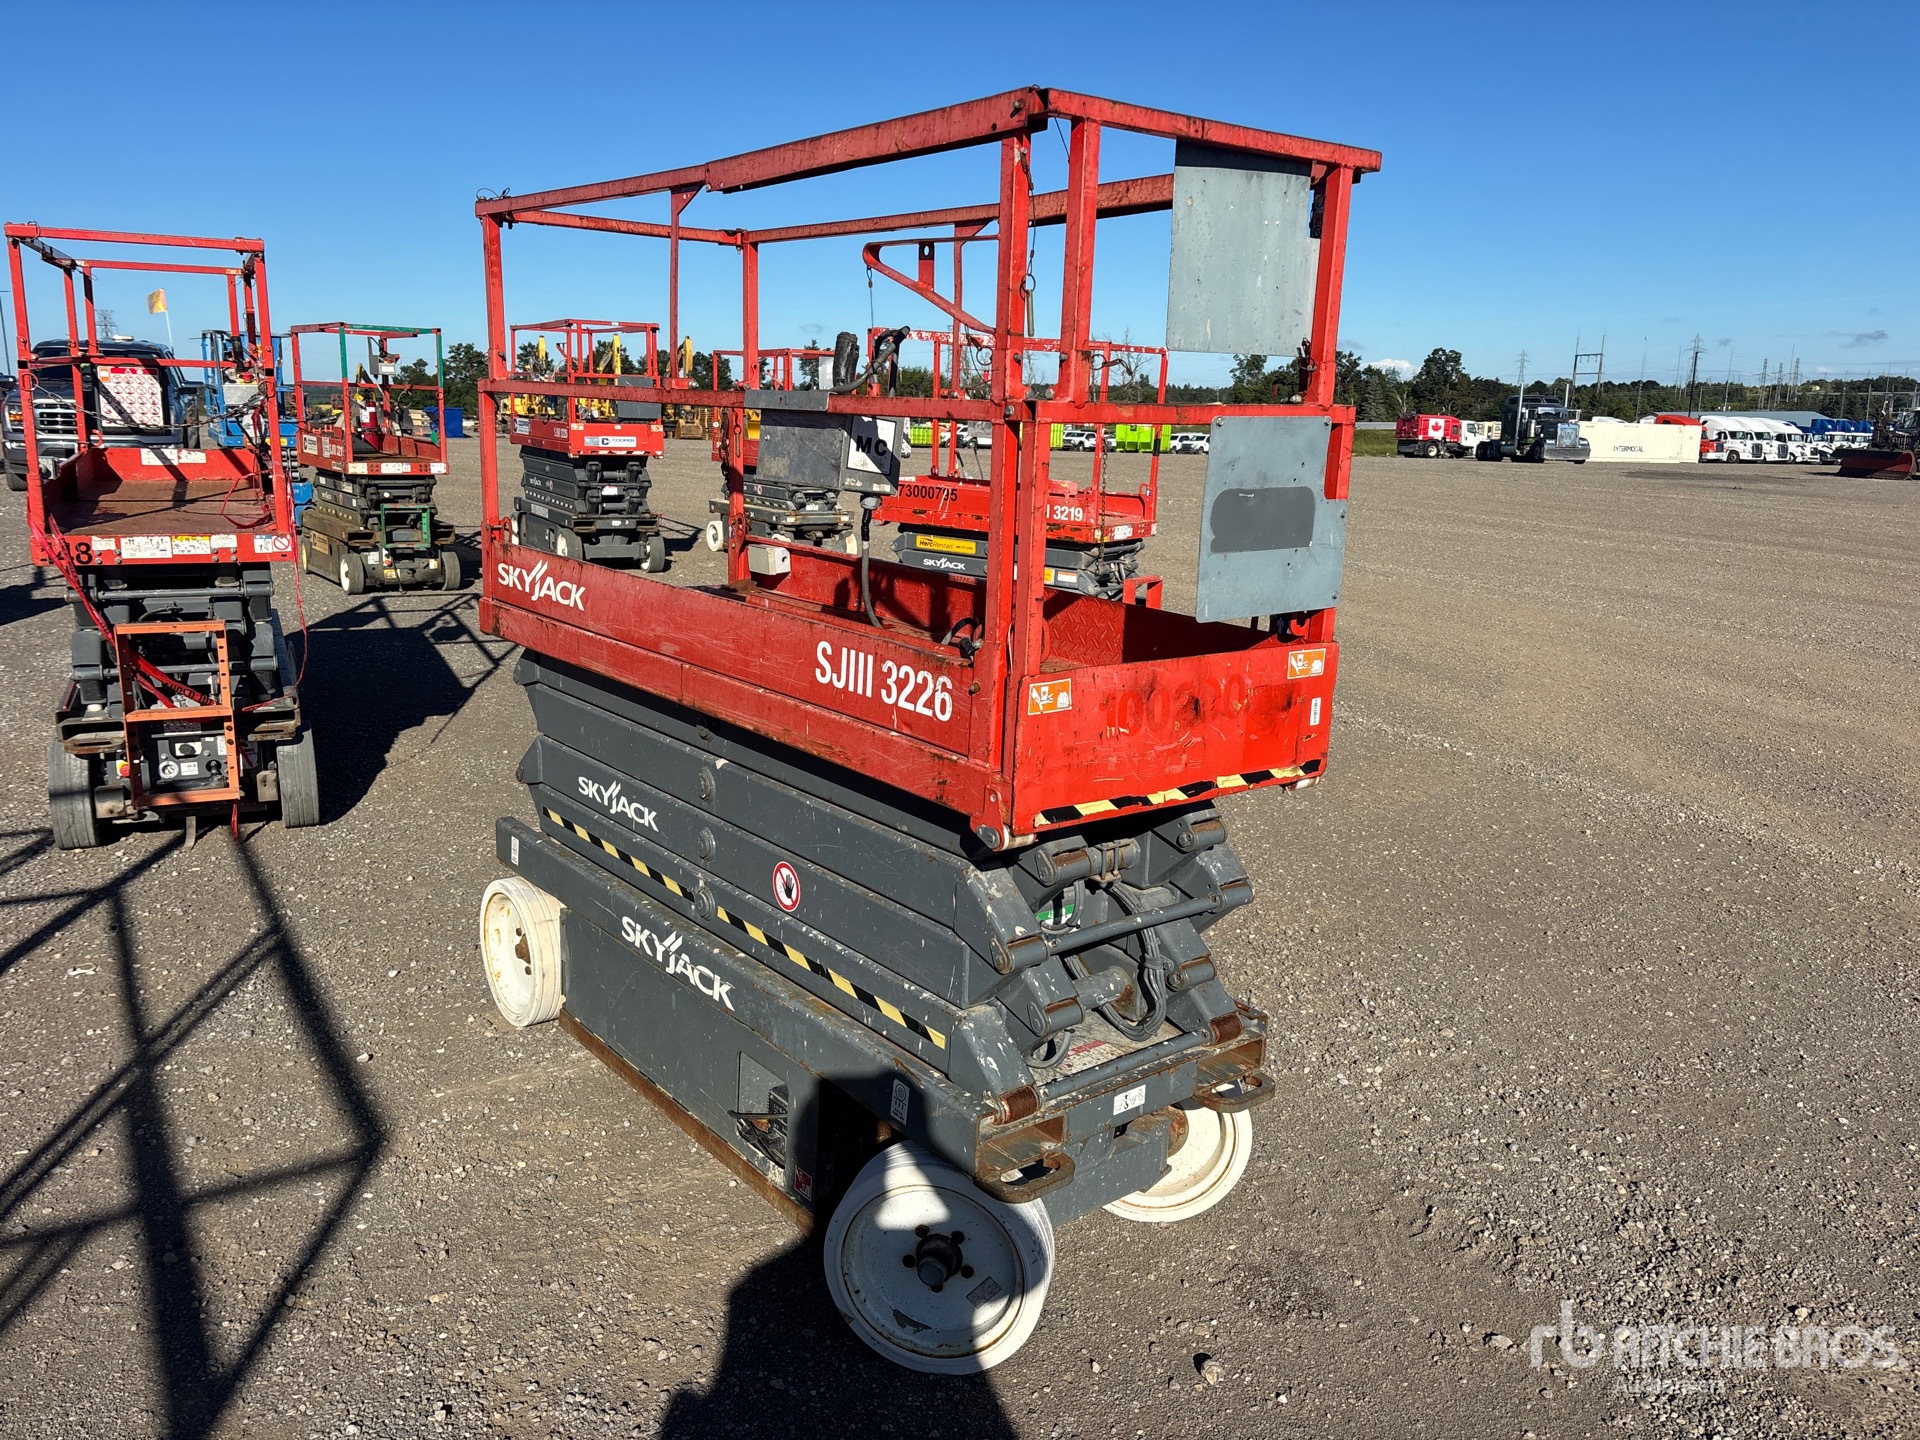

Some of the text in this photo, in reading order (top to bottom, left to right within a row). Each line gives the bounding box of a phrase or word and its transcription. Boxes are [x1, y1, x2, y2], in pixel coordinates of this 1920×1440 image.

[856, 435, 888, 457] MC
[899, 484, 958, 501] 73000795
[1053, 505, 1083, 522] 3219
[923, 557, 966, 570] SKYJACK
[497, 559, 586, 611] SKYJACK
[815, 640, 953, 722] SJIII 3226
[578, 776, 659, 832] SKYJACK
[621, 915, 736, 1012] SKYJACK
